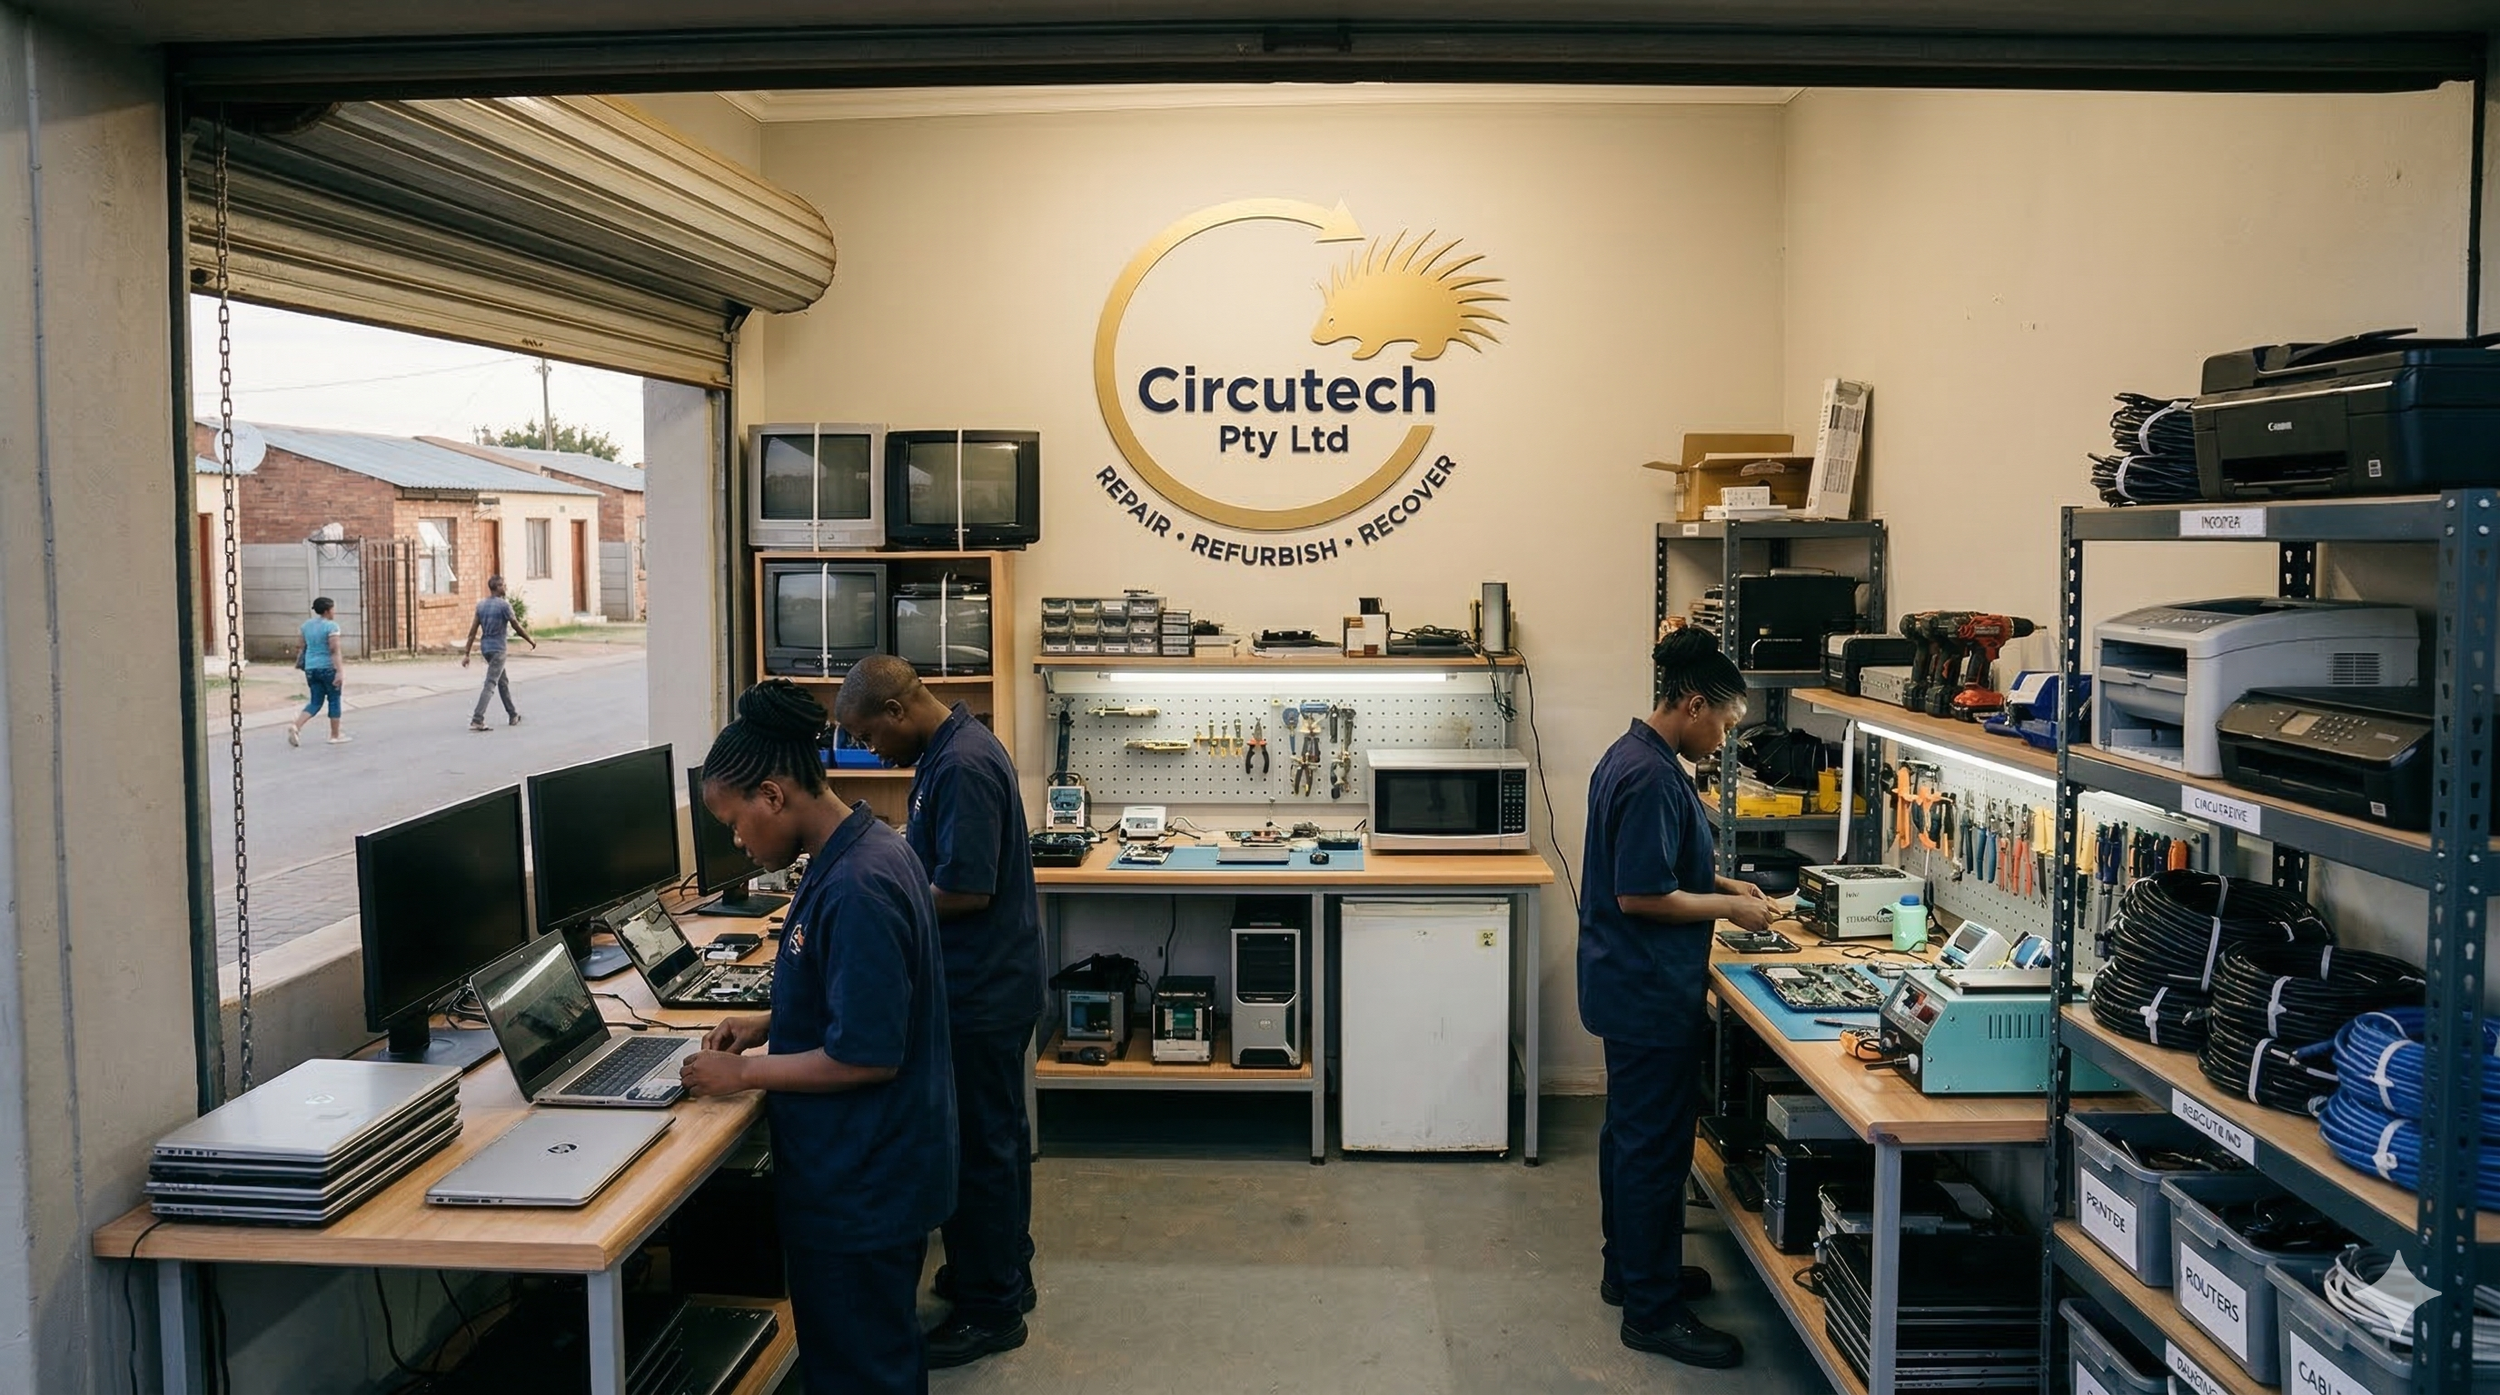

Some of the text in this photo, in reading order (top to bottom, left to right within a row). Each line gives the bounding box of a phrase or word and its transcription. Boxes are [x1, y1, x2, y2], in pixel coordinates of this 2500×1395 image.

[1138, 365, 1436, 414] Circutech
[1220, 424, 1349, 459] Pty Ltd
[1096, 455, 1457, 567] REPAIR REFURBISH RECOVER
[2185, 1266, 2240, 1323] ROUTERS
[2298, 1360, 2342, 1395] CABL
